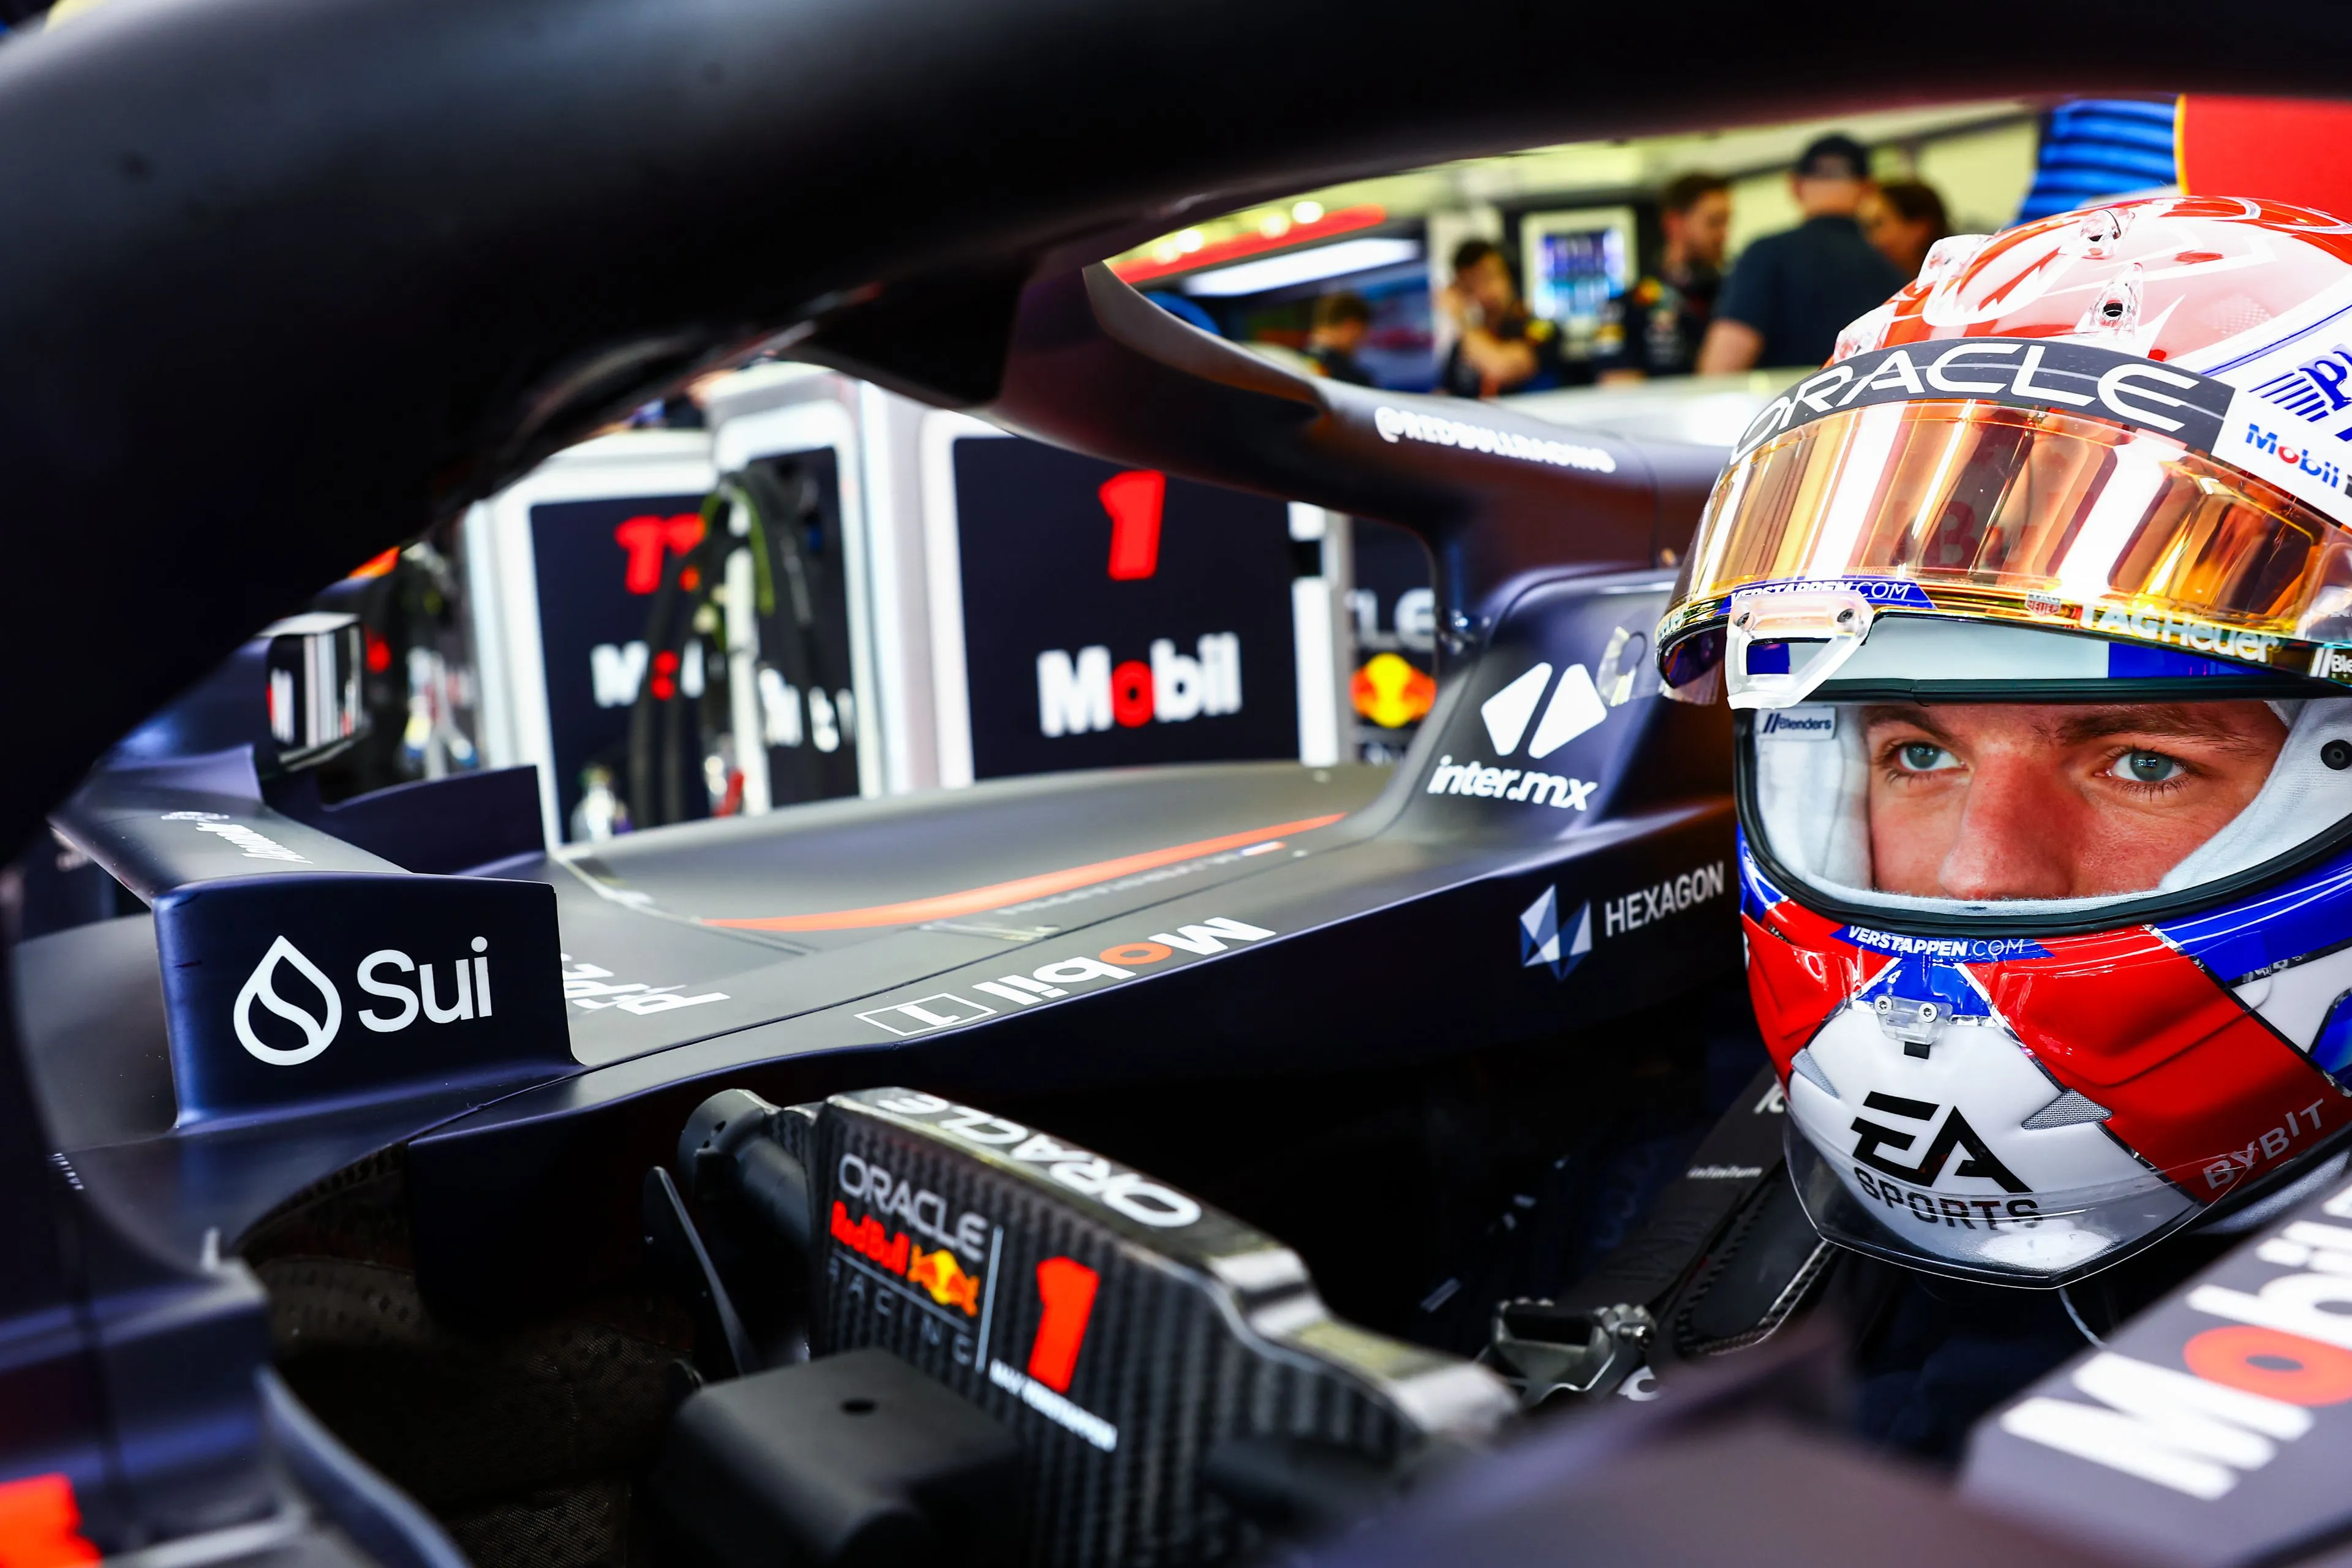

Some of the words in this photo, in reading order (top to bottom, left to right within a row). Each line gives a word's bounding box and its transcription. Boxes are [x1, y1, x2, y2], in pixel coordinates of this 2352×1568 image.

[1730, 342, 2199, 466] ORACLE
[2245, 423, 2340, 488] Mobil
[1098, 469, 1166, 581] 1
[1036, 631, 1242, 737] Mobil
[1427, 755, 1598, 812] inter.mx
[1605, 861, 1724, 937] HEXAGON
[1848, 925, 2024, 957] VERSTAPPEN.COM
[356, 935, 492, 1033] Sui
[972, 916, 1276, 1006] Mobil
[878, 1094, 1202, 1227] ORACLE
[1850, 1091, 2034, 1193] EA
[2203, 1099, 2324, 1189] BYBIT
[839, 1153, 988, 1263] ORACLE
[1854, 1167, 2044, 1230] SPORTS
[1027, 1255, 1100, 1394] 1
